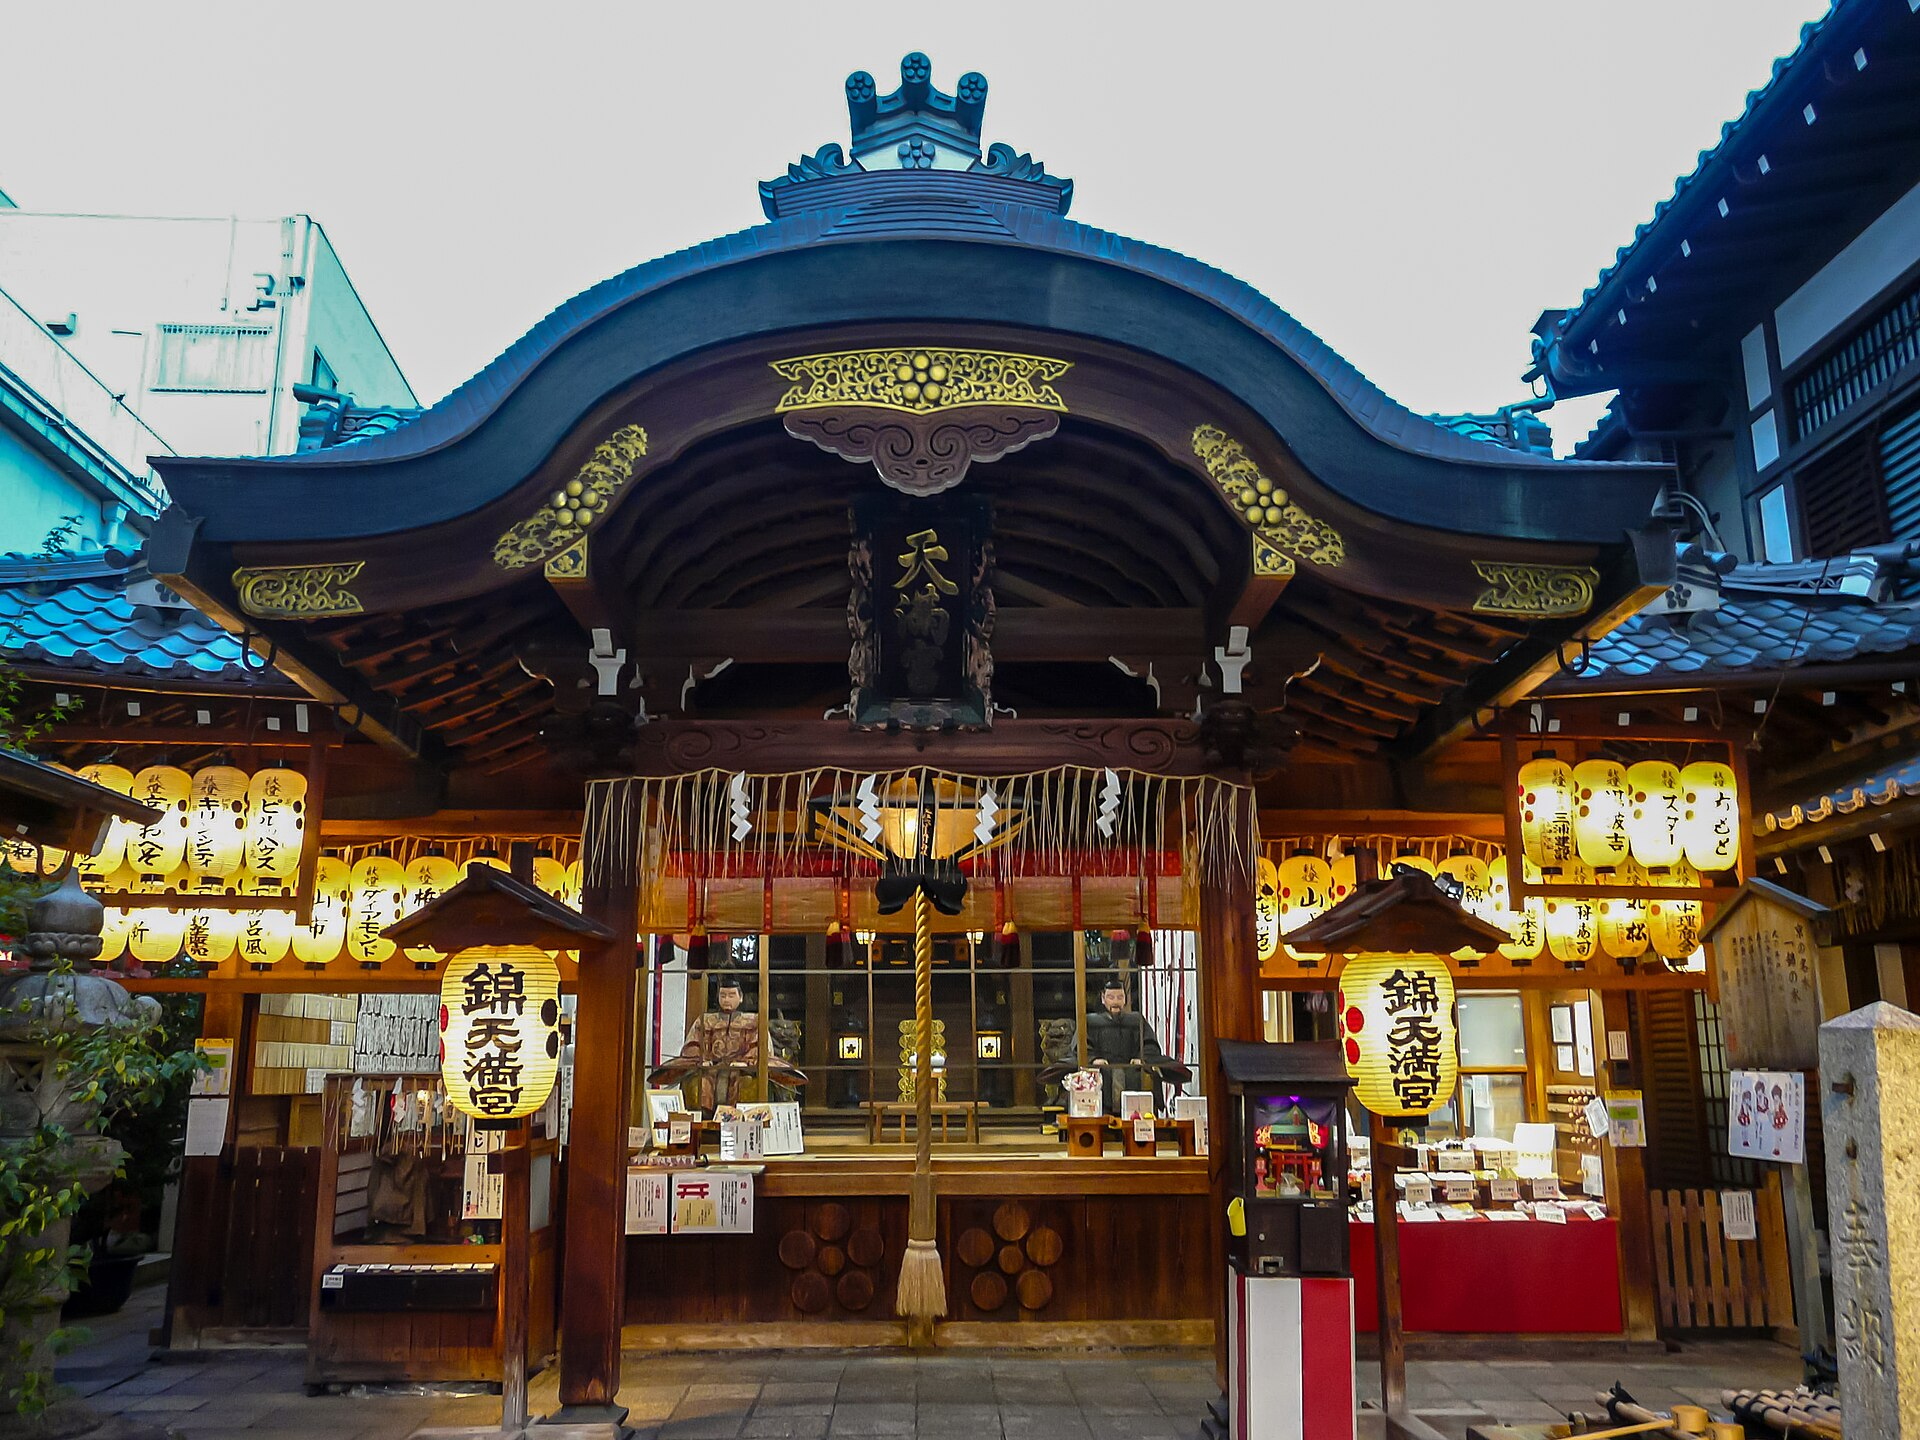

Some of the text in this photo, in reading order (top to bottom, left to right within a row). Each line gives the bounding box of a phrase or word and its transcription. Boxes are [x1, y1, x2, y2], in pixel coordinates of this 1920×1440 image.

[1662, 794, 1680, 846] スター
[461, 962, 527, 1115] 錦天満宮
[1379, 969, 1442, 1110] 錦天満宮
